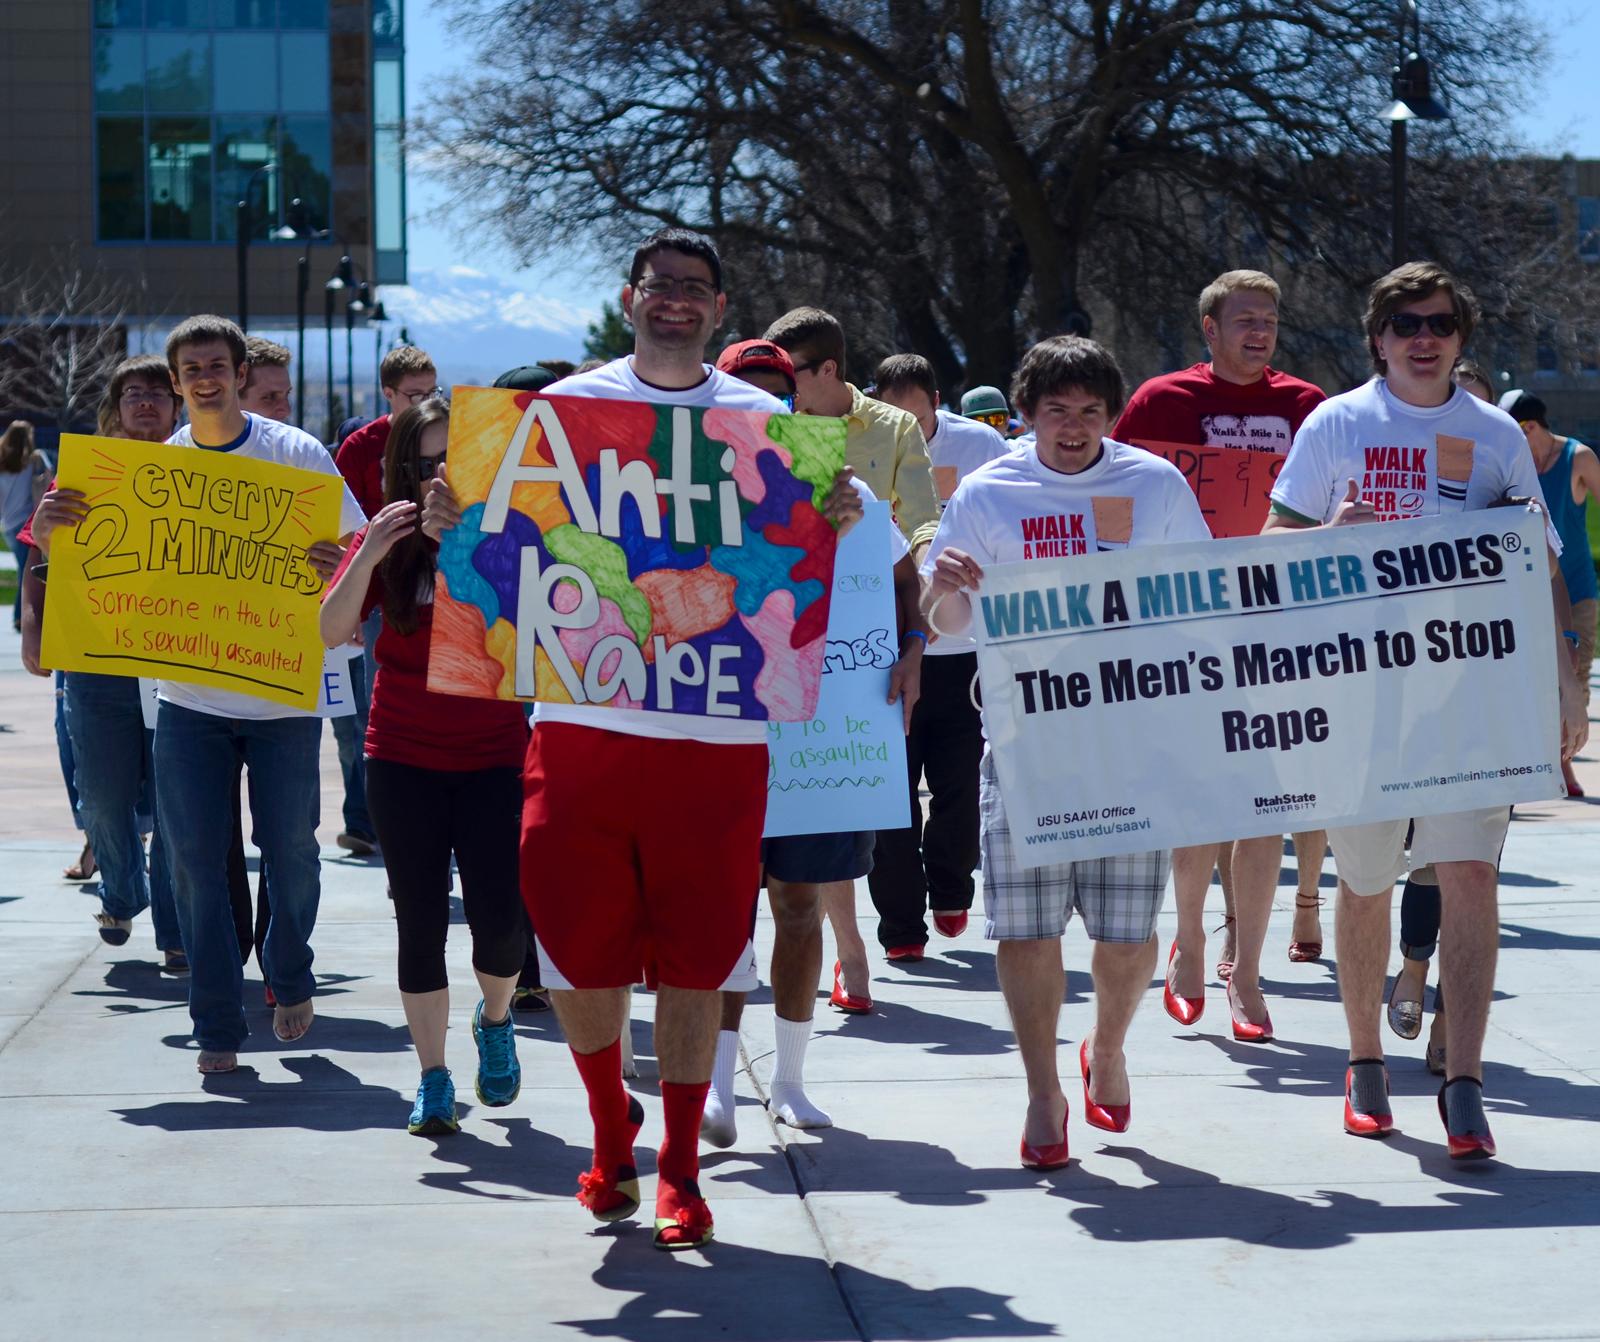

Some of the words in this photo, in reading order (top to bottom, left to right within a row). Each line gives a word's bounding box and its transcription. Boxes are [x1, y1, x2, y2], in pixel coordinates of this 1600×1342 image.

[1211, 427, 1238, 437] Walk
[1239, 429, 1247, 437] A
[1250, 428, 1272, 438] Mile
[1276, 430, 1286, 439] in
[479, 398, 743, 547] Anti
[1364, 447, 1427, 473] WALK
[1363, 473, 1371, 489] A
[1375, 472, 1408, 489] MILE
[1412, 474, 1427, 491] IN
[133, 463, 294, 543] every
[1021, 514, 1085, 542] WALK
[74, 503, 141, 581] 2
[147, 518, 323, 596] MINUTES
[1024, 543, 1032, 560] A
[1036, 540, 1068, 559] MILE
[1072, 539, 1087, 556] IN
[980, 583, 1096, 638] WALK
[1102, 579, 1130, 625] A
[1136, 567, 1231, 619] MILE
[1237, 563, 1281, 608] IN
[1287, 554, 1367, 602] HER
[213, 603, 229, 621] in
[236, 600, 263, 628] the
[143, 629, 220, 669] sexually
[226, 642, 303, 674] assaulted
[822, 629, 896, 675] mes
[1015, 669, 1092, 714] The
[1099, 650, 1224, 704] Men's
[1232, 632, 1367, 688] March
[1374, 629, 1416, 669] to
[1425, 618, 1516, 663] Stop
[1222, 706, 1330, 753] Rape
[790, 740, 889, 770] assaulted
[1380, 763, 1553, 793] www.walkamileinhershoes.org
[1037, 814, 1061, 827] USU
[1063, 810, 1099, 824] SAAVI
[1101, 804, 1136, 819] Office
[1255, 801, 1317, 816] UNIVERSITY
[1025, 817, 1151, 846] www.usu.edu/saavi
